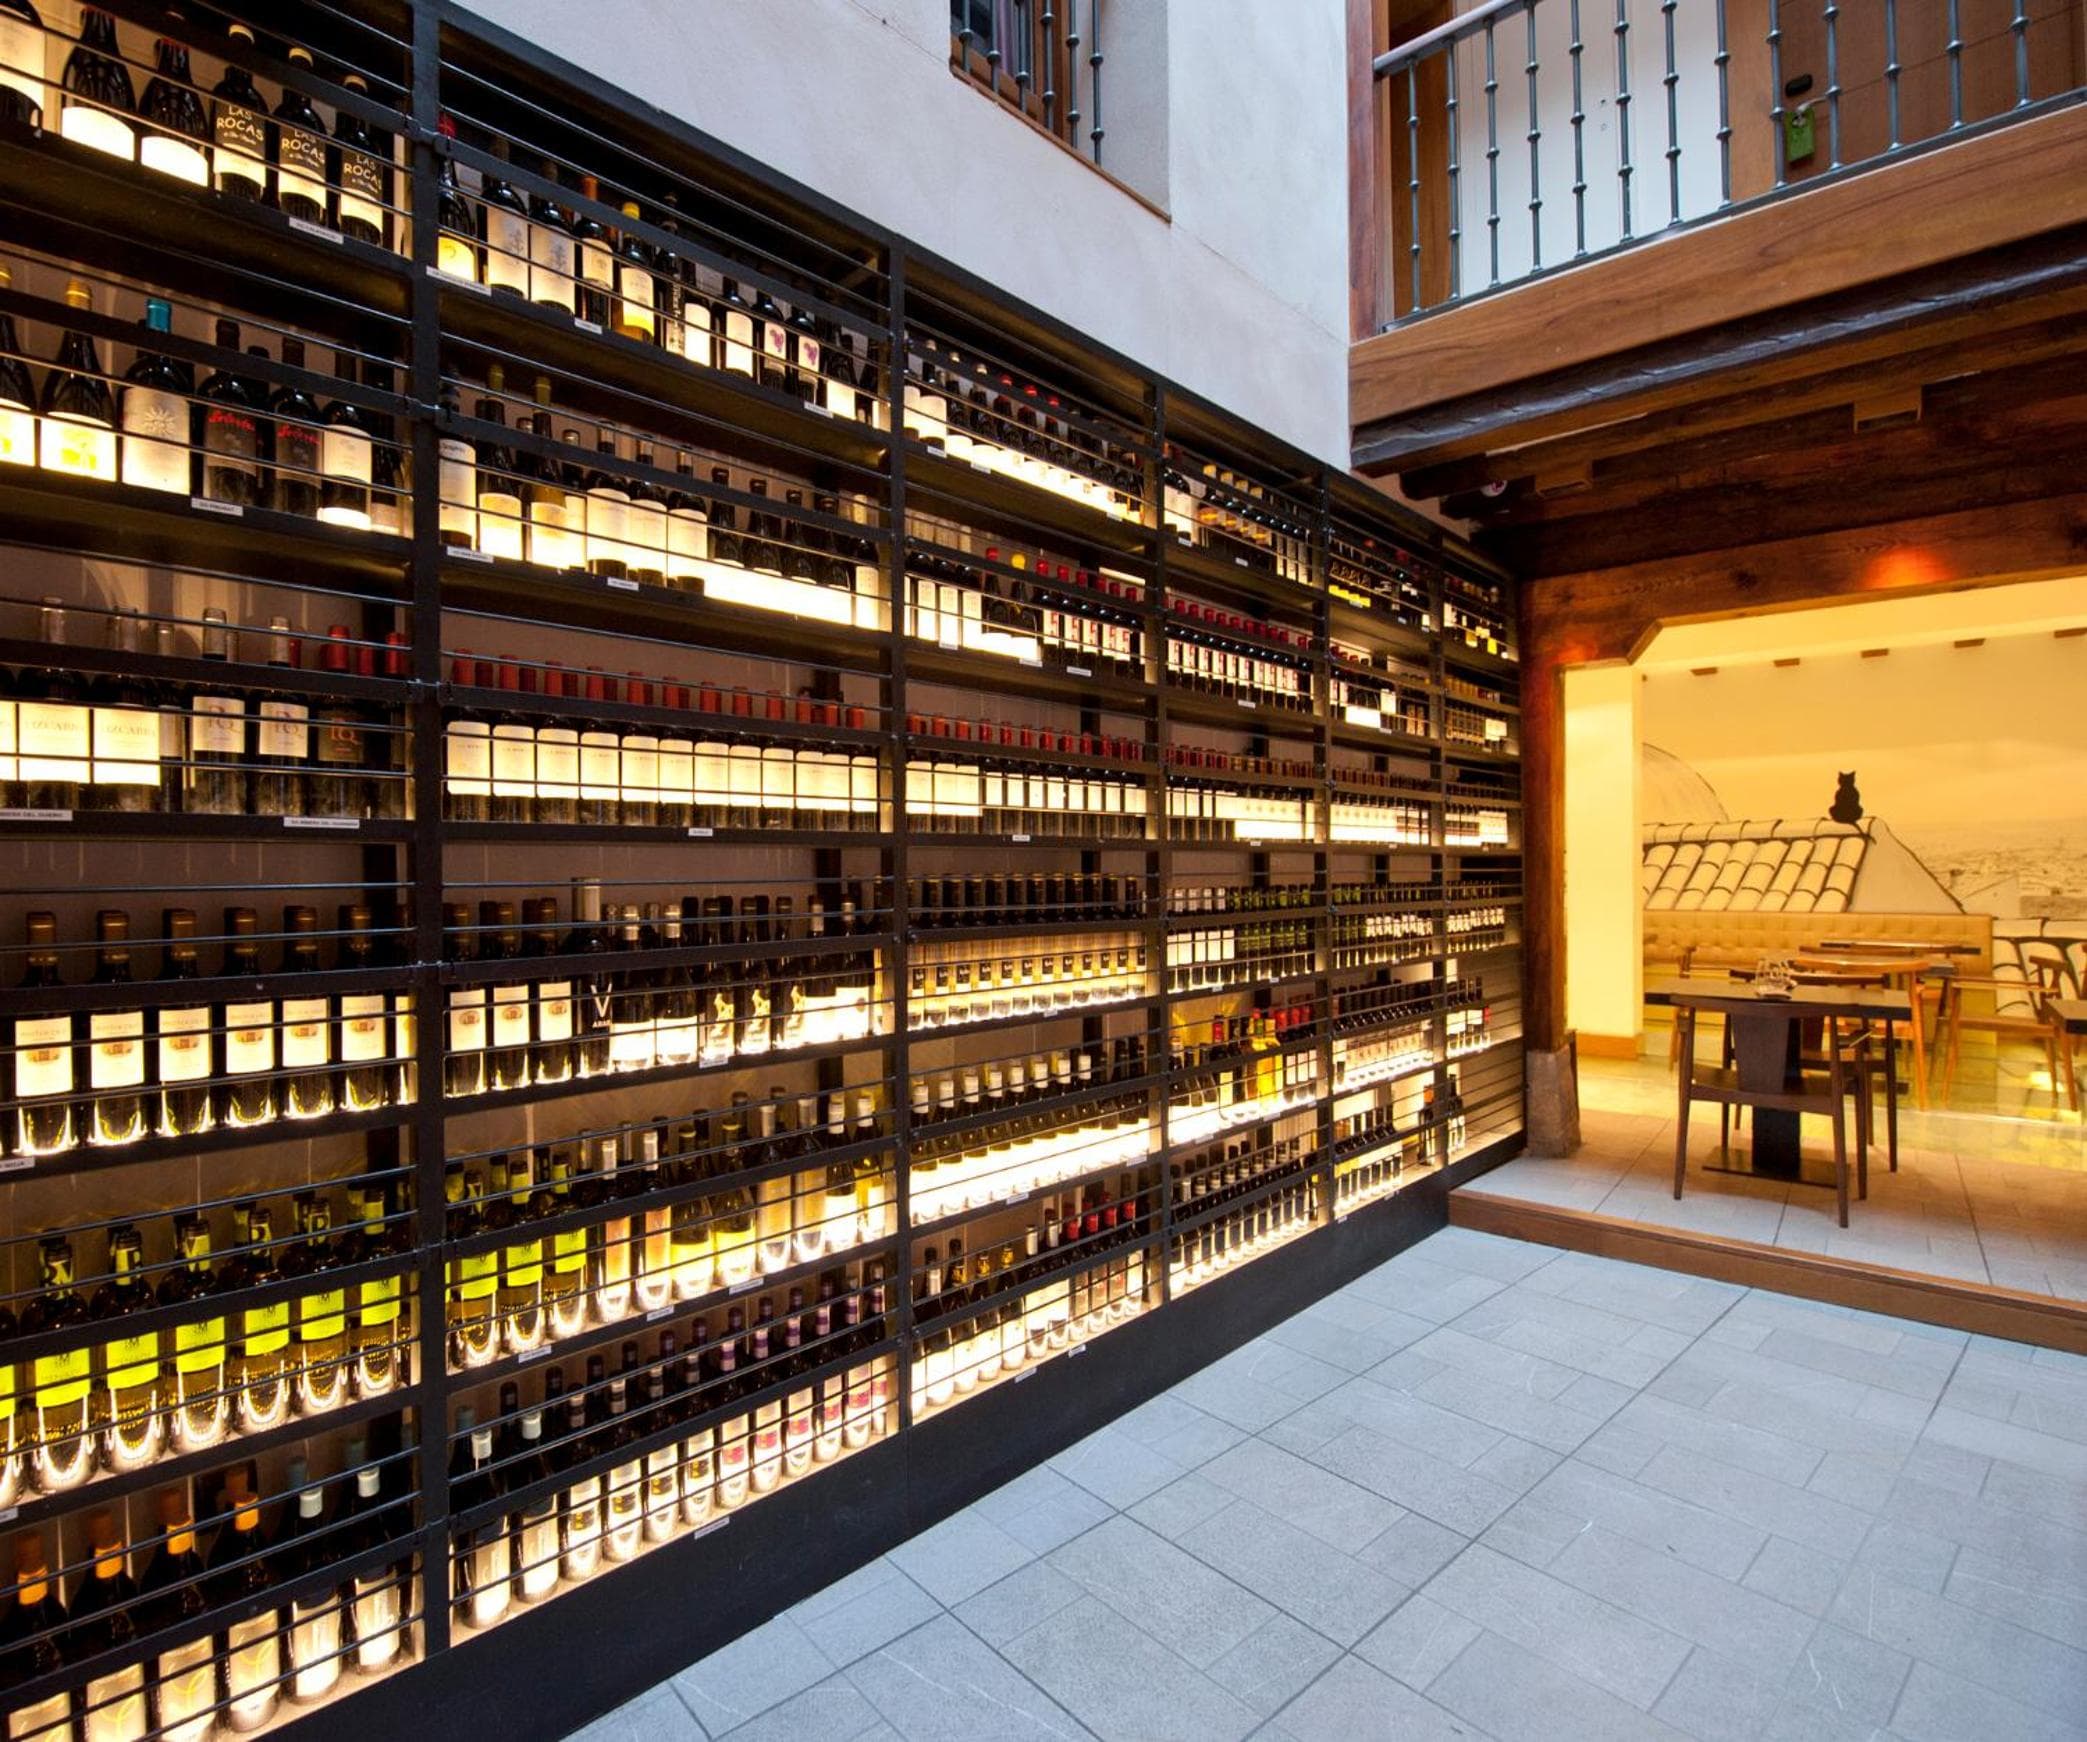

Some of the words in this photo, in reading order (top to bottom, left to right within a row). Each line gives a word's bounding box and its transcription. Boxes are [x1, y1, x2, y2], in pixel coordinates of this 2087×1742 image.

[228, 104, 253, 121] LAS
[216, 116, 264, 142] ROCAS
[281, 137, 325, 164] ROCAS
[356, 153, 377, 171] LAS
